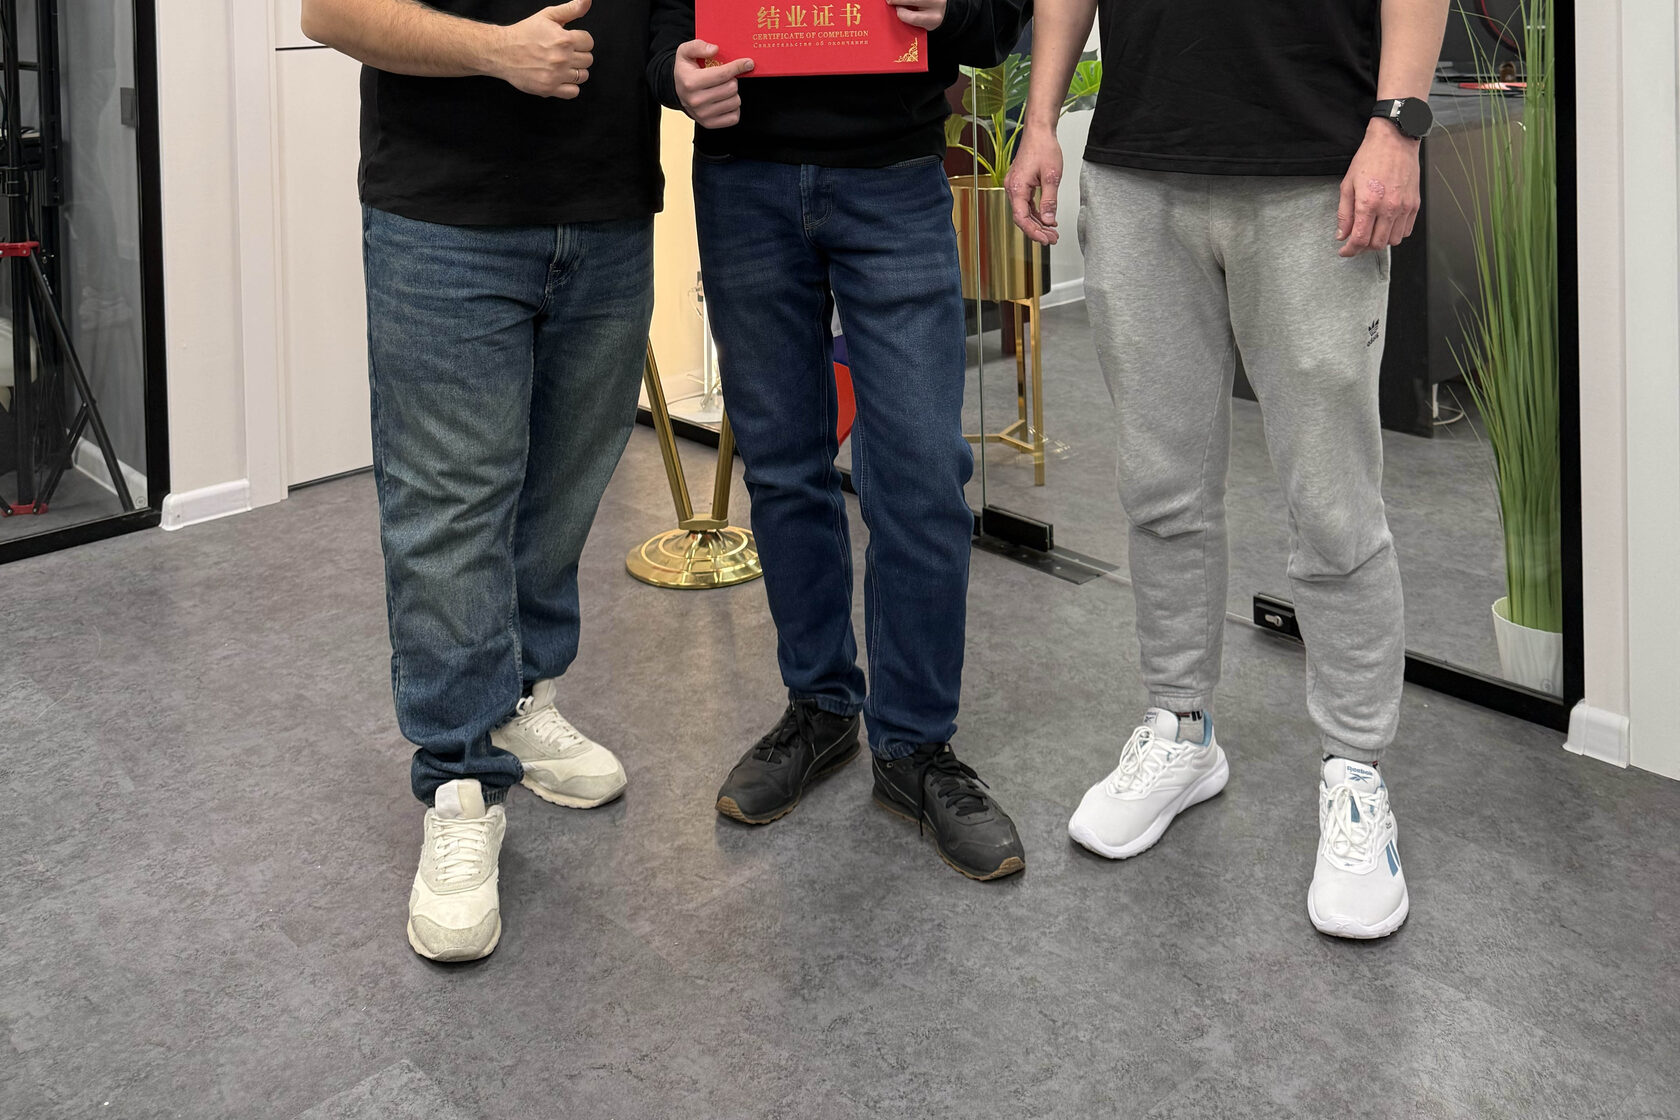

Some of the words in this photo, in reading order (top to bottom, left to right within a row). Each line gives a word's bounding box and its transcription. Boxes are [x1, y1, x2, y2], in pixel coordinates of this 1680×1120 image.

[757, 3, 862, 30] 结业证书
[752, 32, 805, 41] CERTIFICATE
[817, 30, 869, 39] COMPLETION
